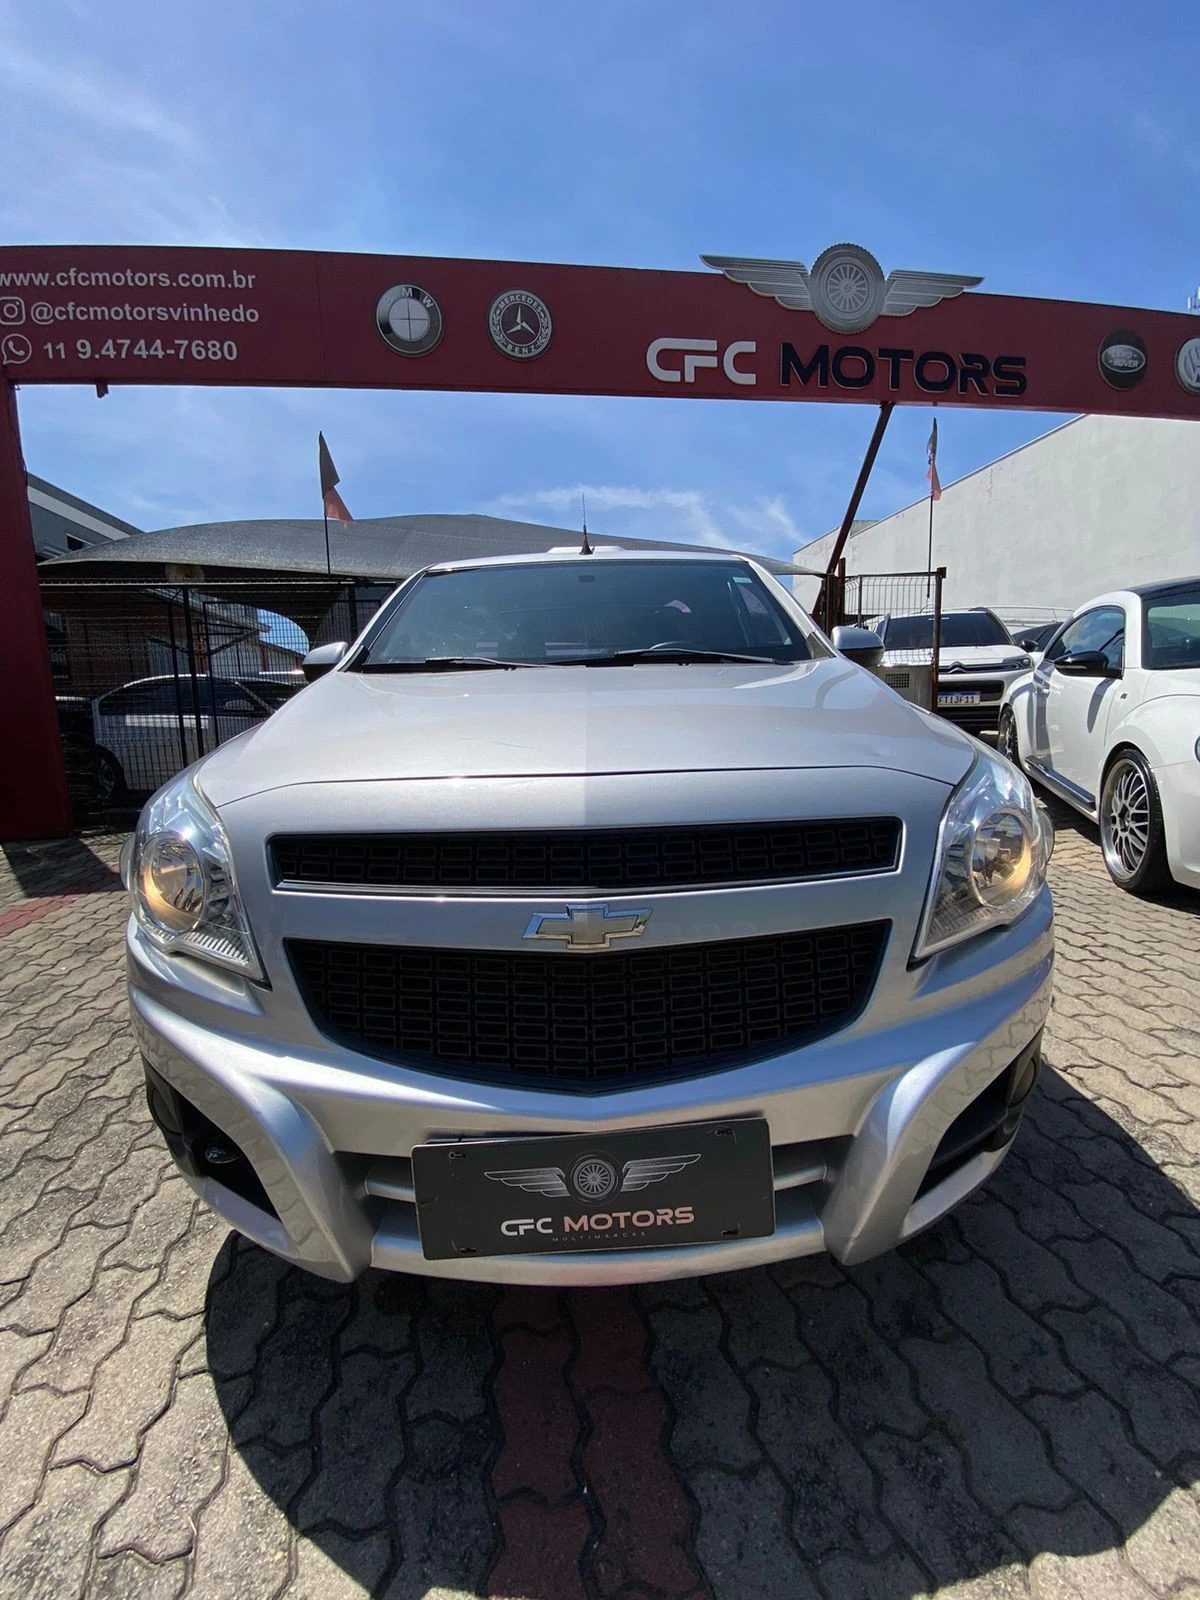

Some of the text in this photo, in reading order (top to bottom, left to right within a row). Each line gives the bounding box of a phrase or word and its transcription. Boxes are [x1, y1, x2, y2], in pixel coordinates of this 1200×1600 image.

[0, 268, 256, 288] www.cfcmotors.com.br
[386, 287, 434, 309] MW
[498, 294, 543, 312] MERCEDES
[31, 302, 259, 325] @cfcmotorsvinhedo
[44, 339, 238, 360] 11 9.4744-7680
[507, 344, 537, 354] BENZ
[646, 337, 1028, 397] CFC MOTORS
[500, 1206, 695, 1236] CFC MOTORS
